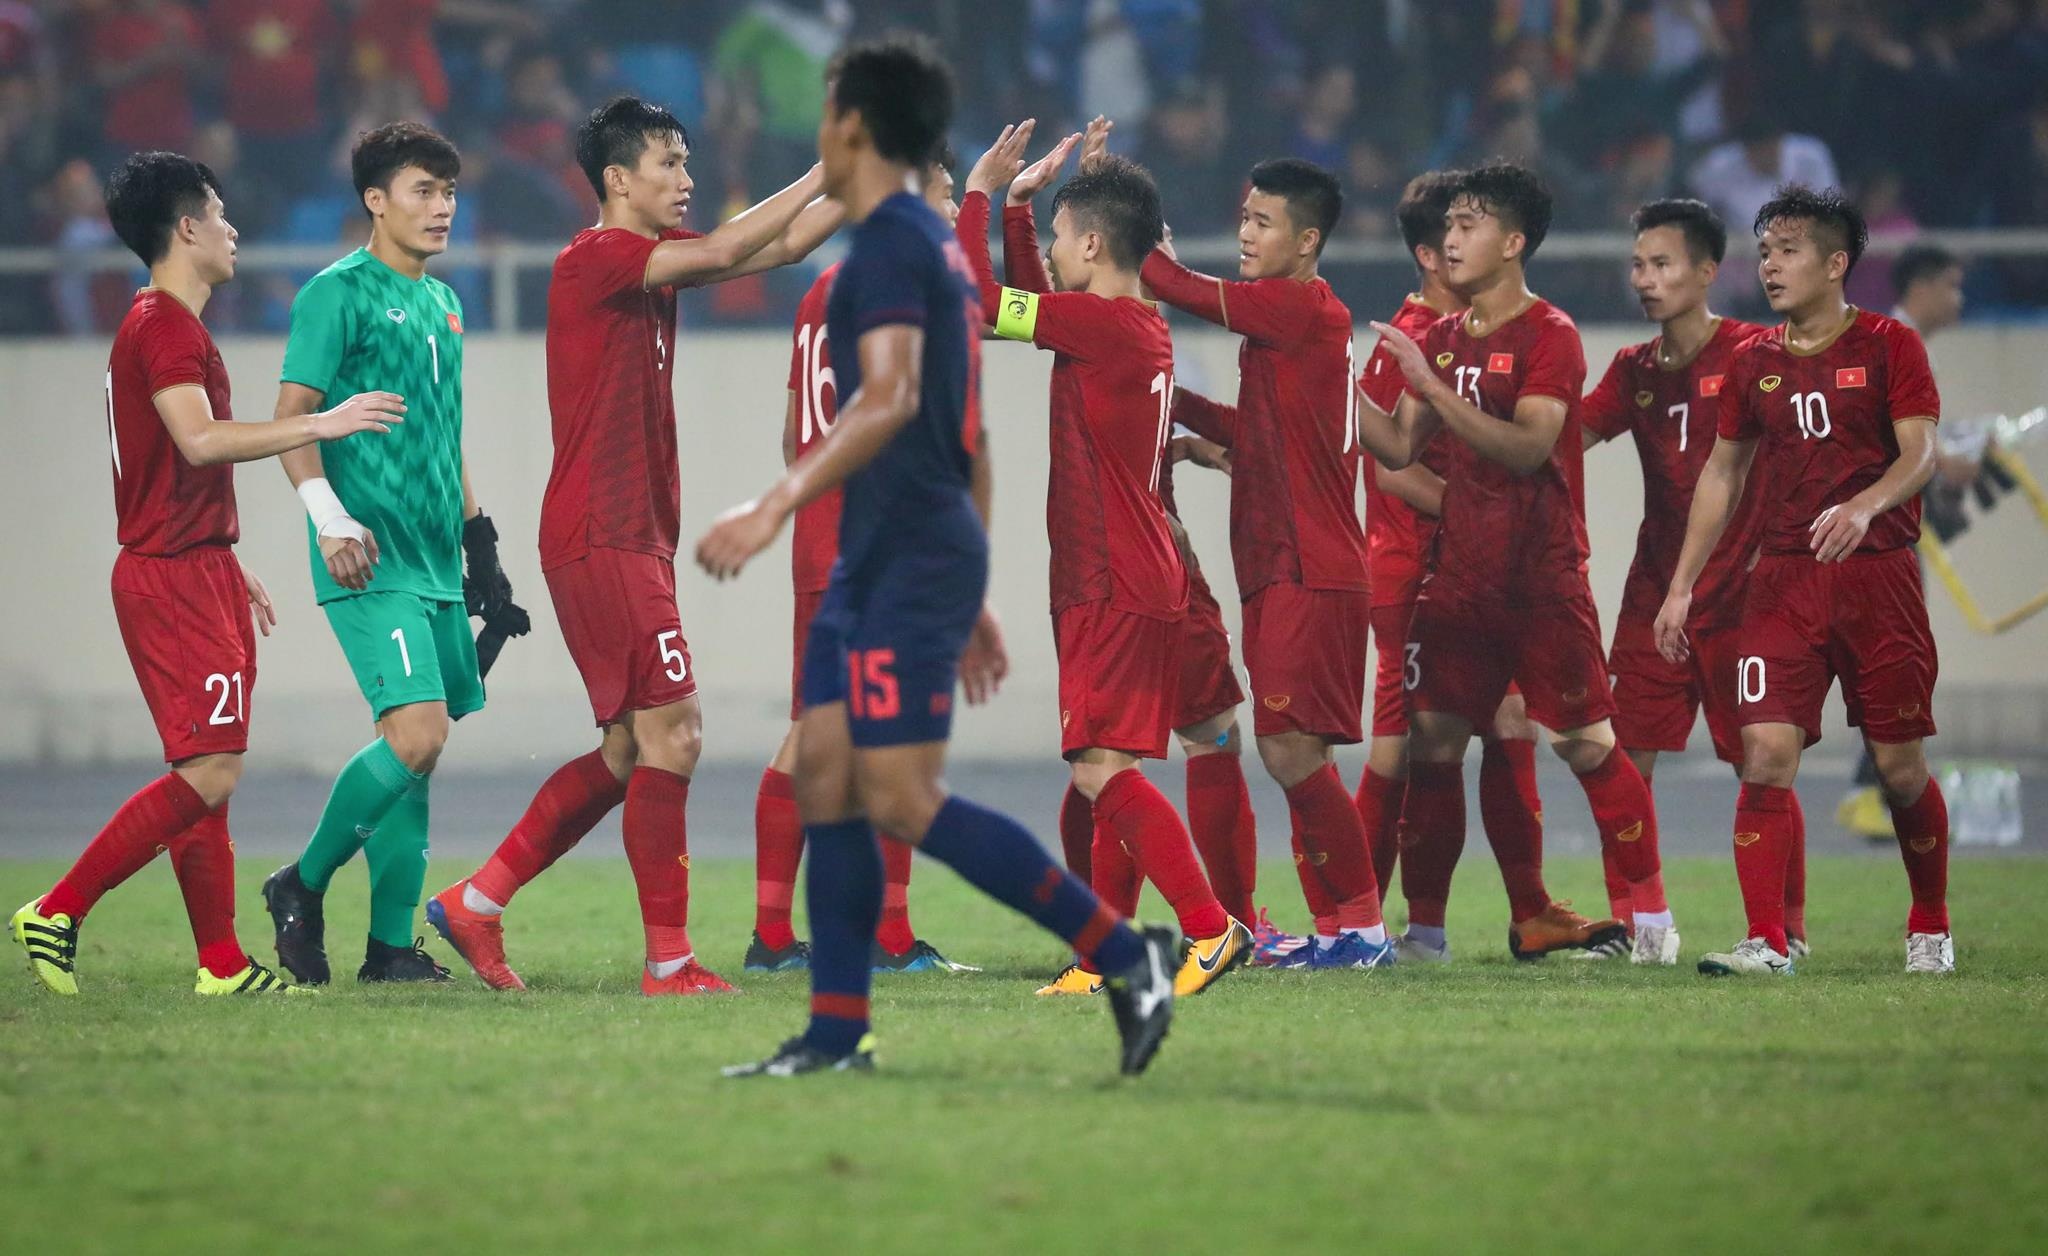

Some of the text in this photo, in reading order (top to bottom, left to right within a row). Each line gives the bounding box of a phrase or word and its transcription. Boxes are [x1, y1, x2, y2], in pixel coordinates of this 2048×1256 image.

[427, 335, 439, 384] 1
[798, 323, 839, 444] 16
[1455, 365, 1482, 409] 13
[1668, 402, 1689, 452] 7
[1790, 391, 1832, 440] 10
[391, 628, 412, 677] 1
[657, 630, 687, 682] 5
[1402, 642, 1421, 691] 3
[205, 671, 244, 726] 21
[848, 648, 901, 720] 15
[1737, 656, 1766, 706] 10
